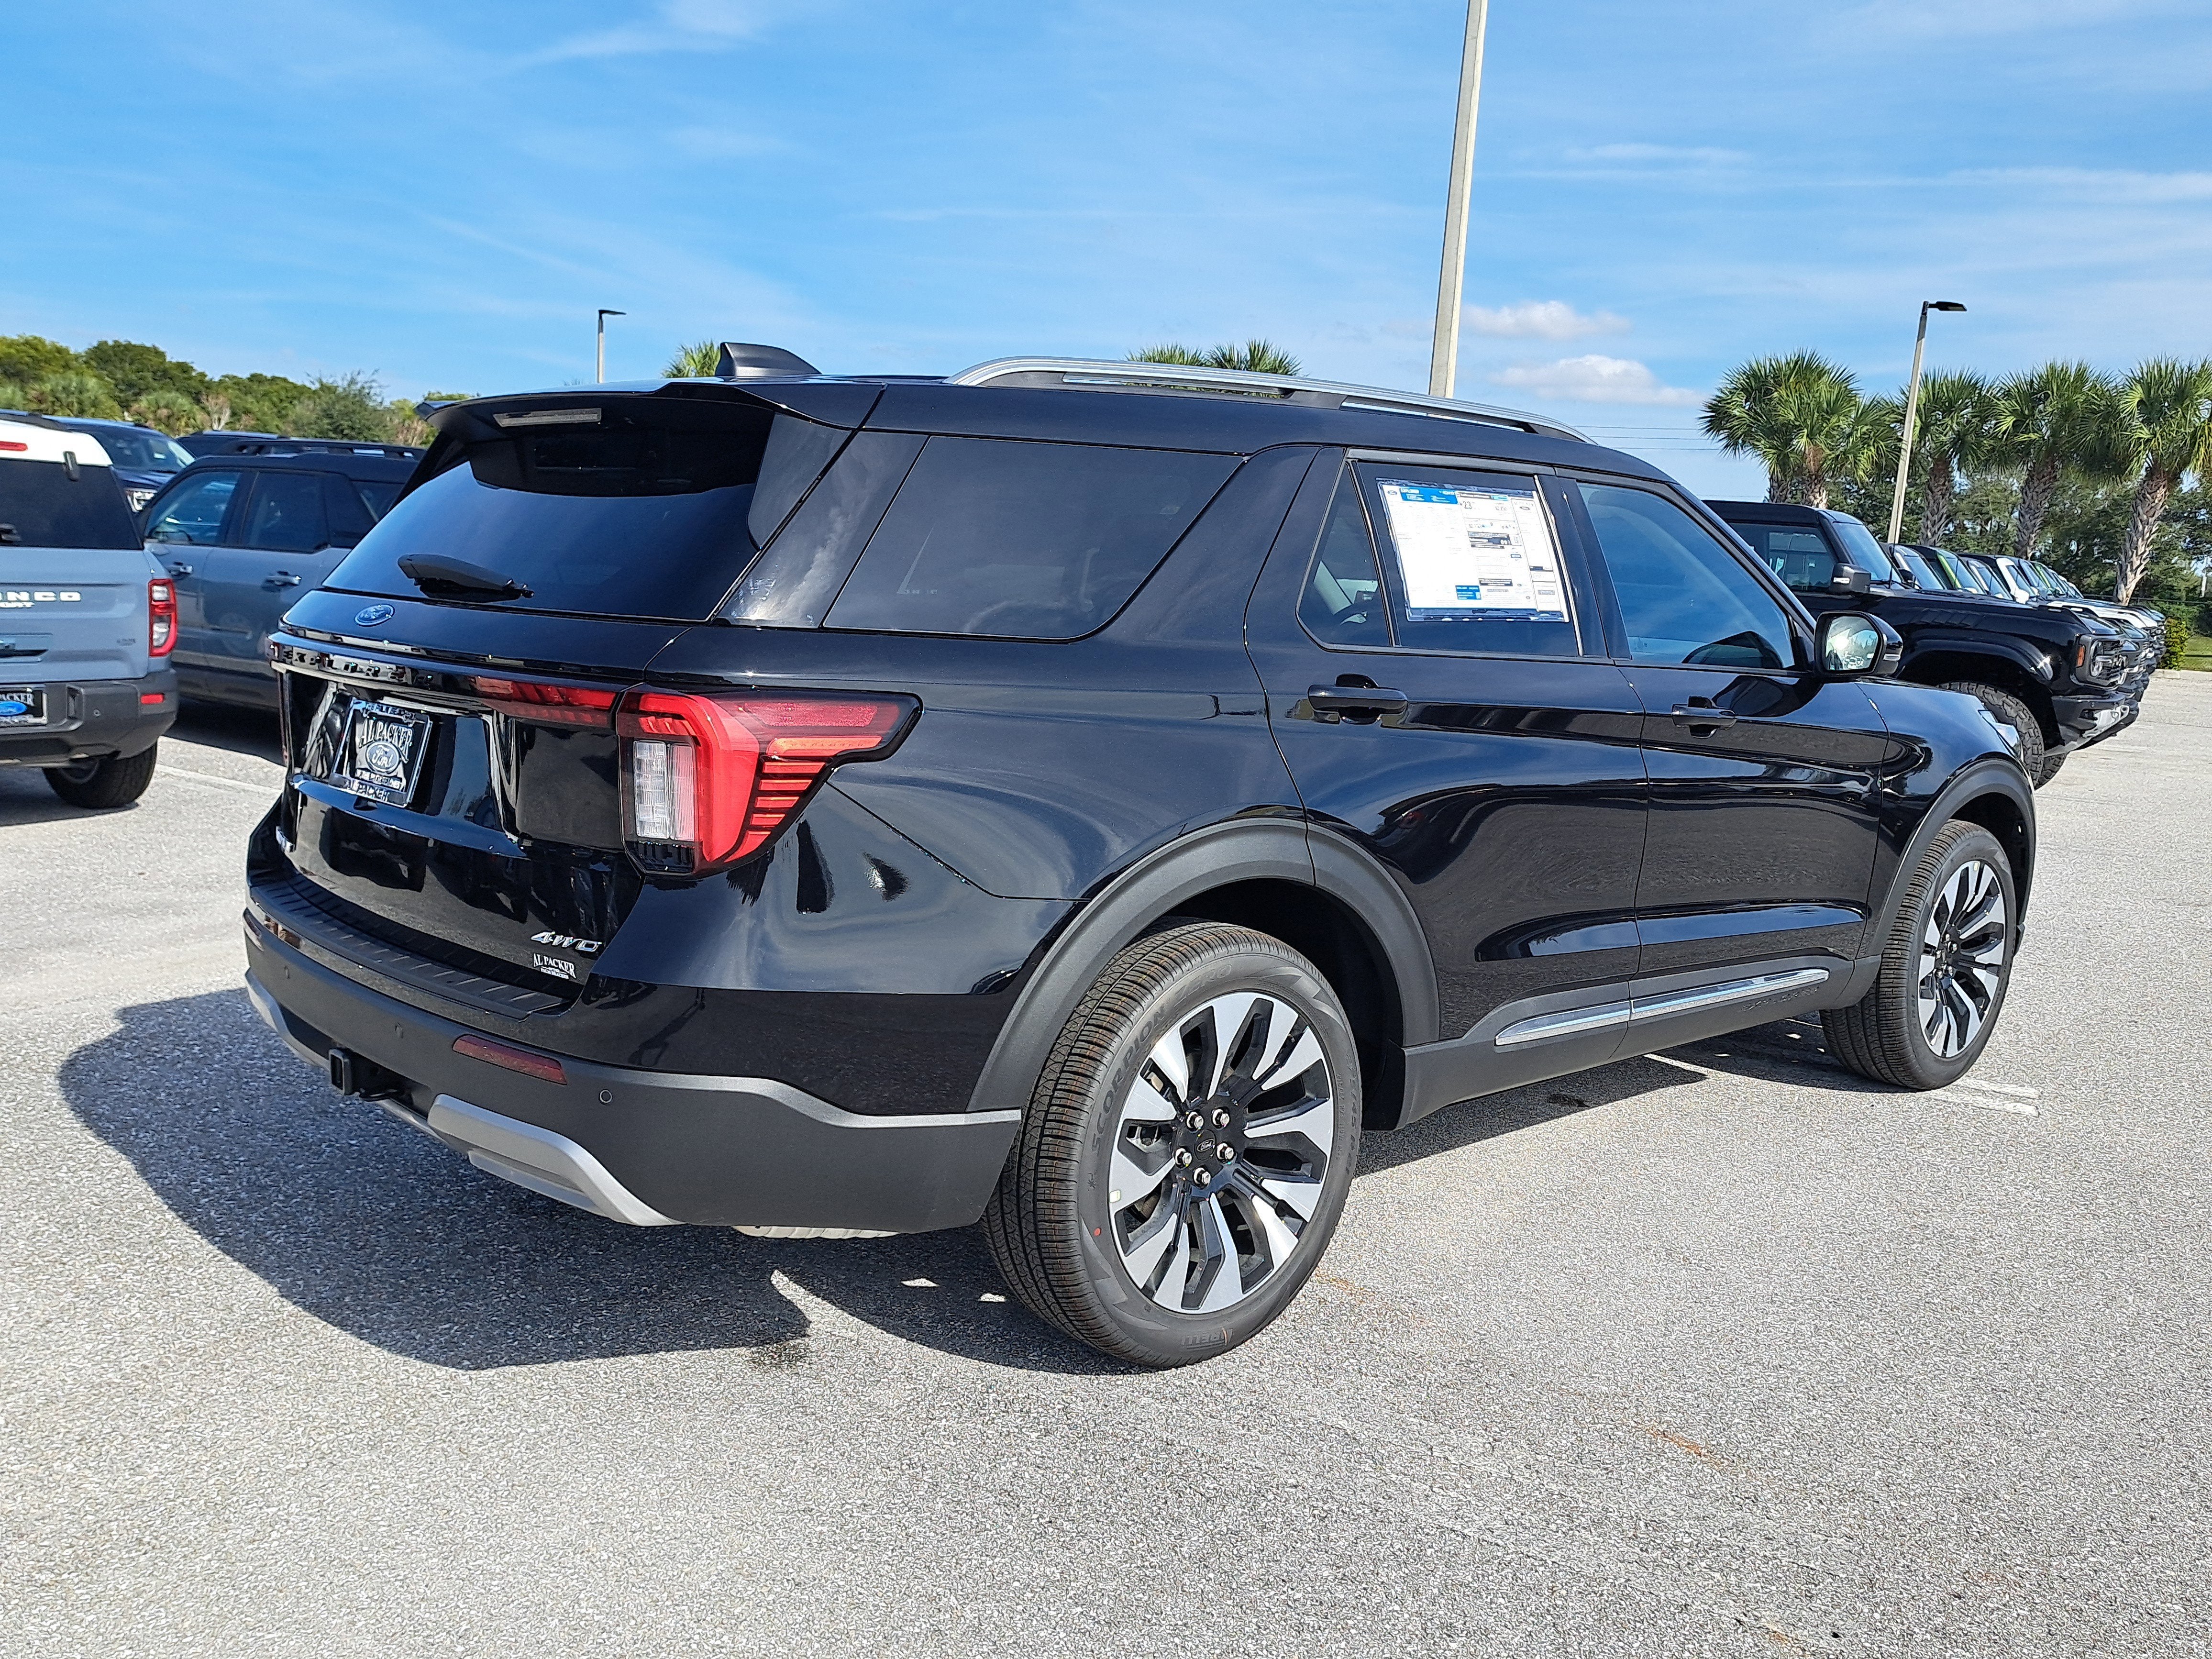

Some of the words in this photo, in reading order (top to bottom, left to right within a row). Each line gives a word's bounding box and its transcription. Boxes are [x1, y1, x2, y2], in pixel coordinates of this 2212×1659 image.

[0, 592, 81, 601] NCO
[375, 720, 412, 759] PACKER
[370, 743, 396, 768] Ford
[531, 931, 602, 952] 4WD
[533, 953, 543, 967] AL
[543, 955, 576, 979] PACKER
[1091, 1006, 1166, 1152] SCORPION
[1173, 964, 1232, 1007] ZERO
